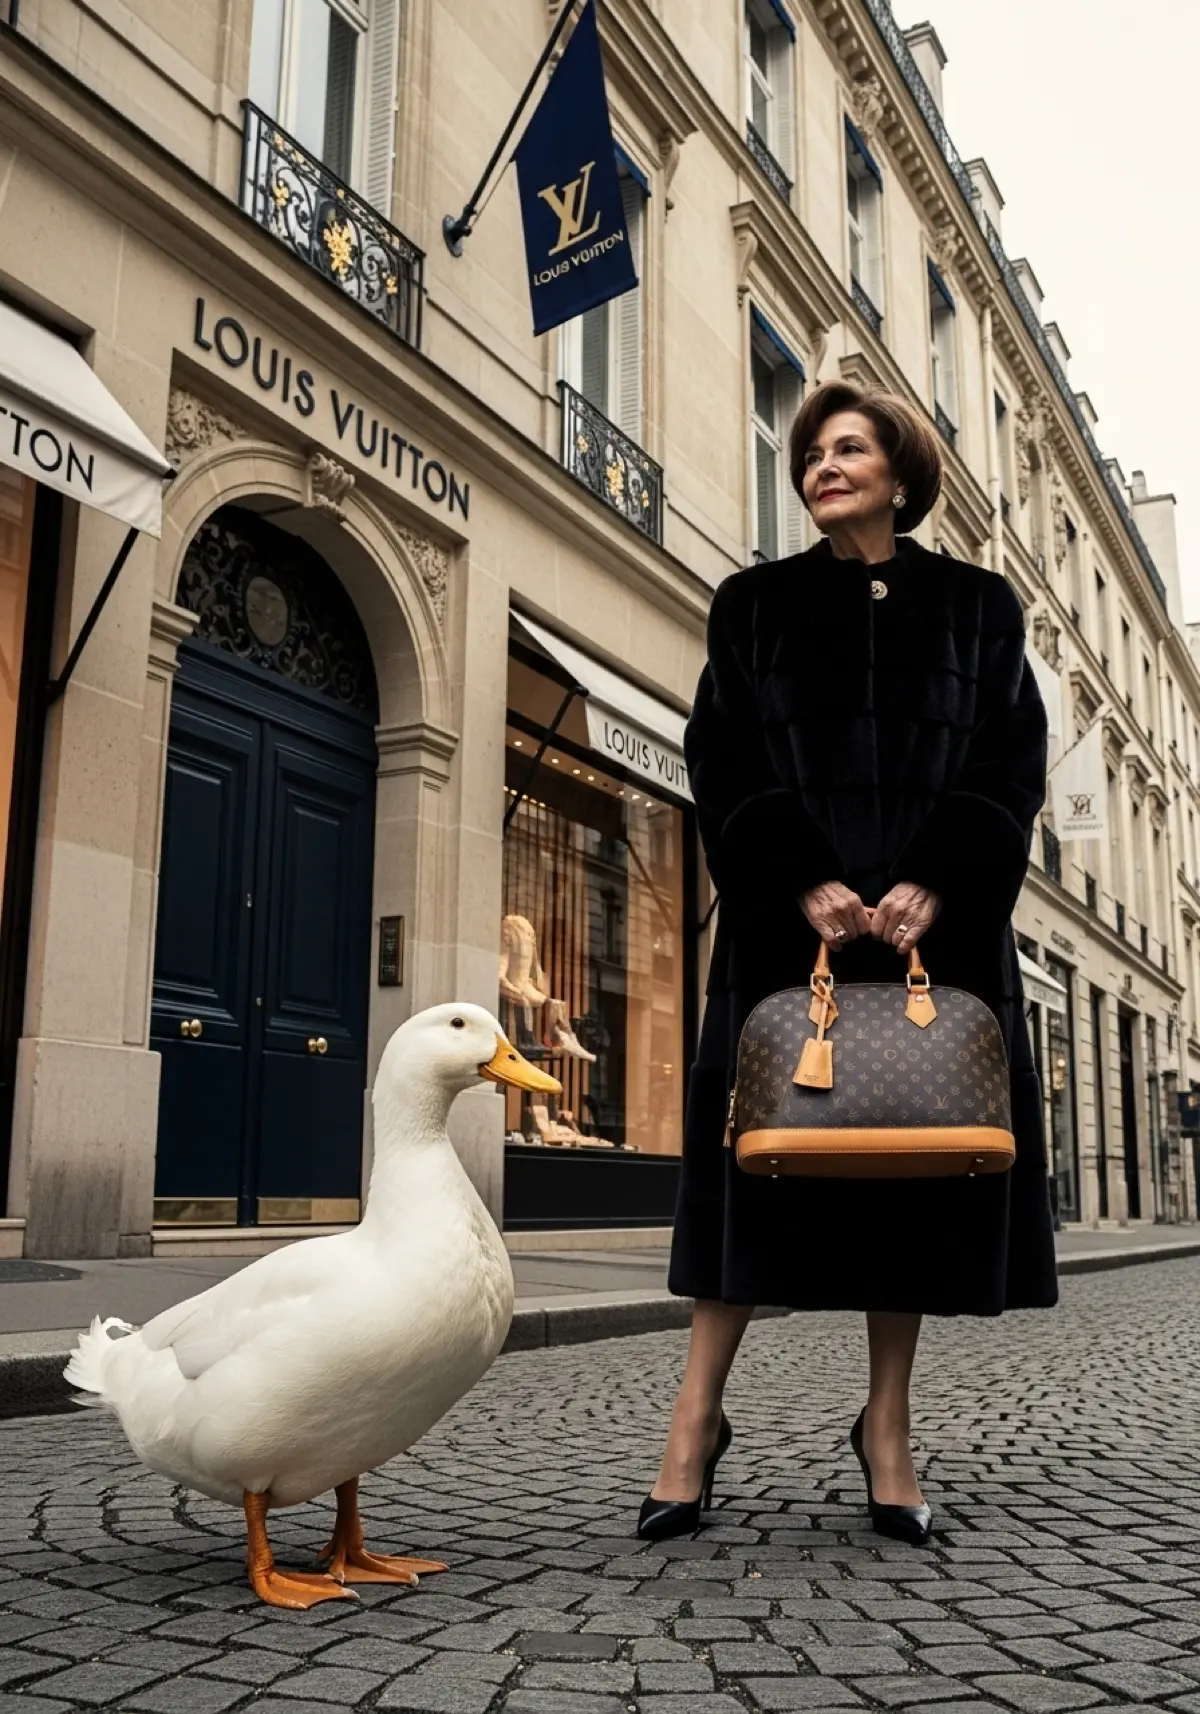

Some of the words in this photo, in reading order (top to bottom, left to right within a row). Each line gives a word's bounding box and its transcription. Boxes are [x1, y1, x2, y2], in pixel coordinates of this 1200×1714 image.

[570, 229, 624, 266] VUITTON
[194, 297, 315, 417] LOUIS
[331, 389, 470, 522] VUITTON
[605, 722, 650, 770] LOUIS
